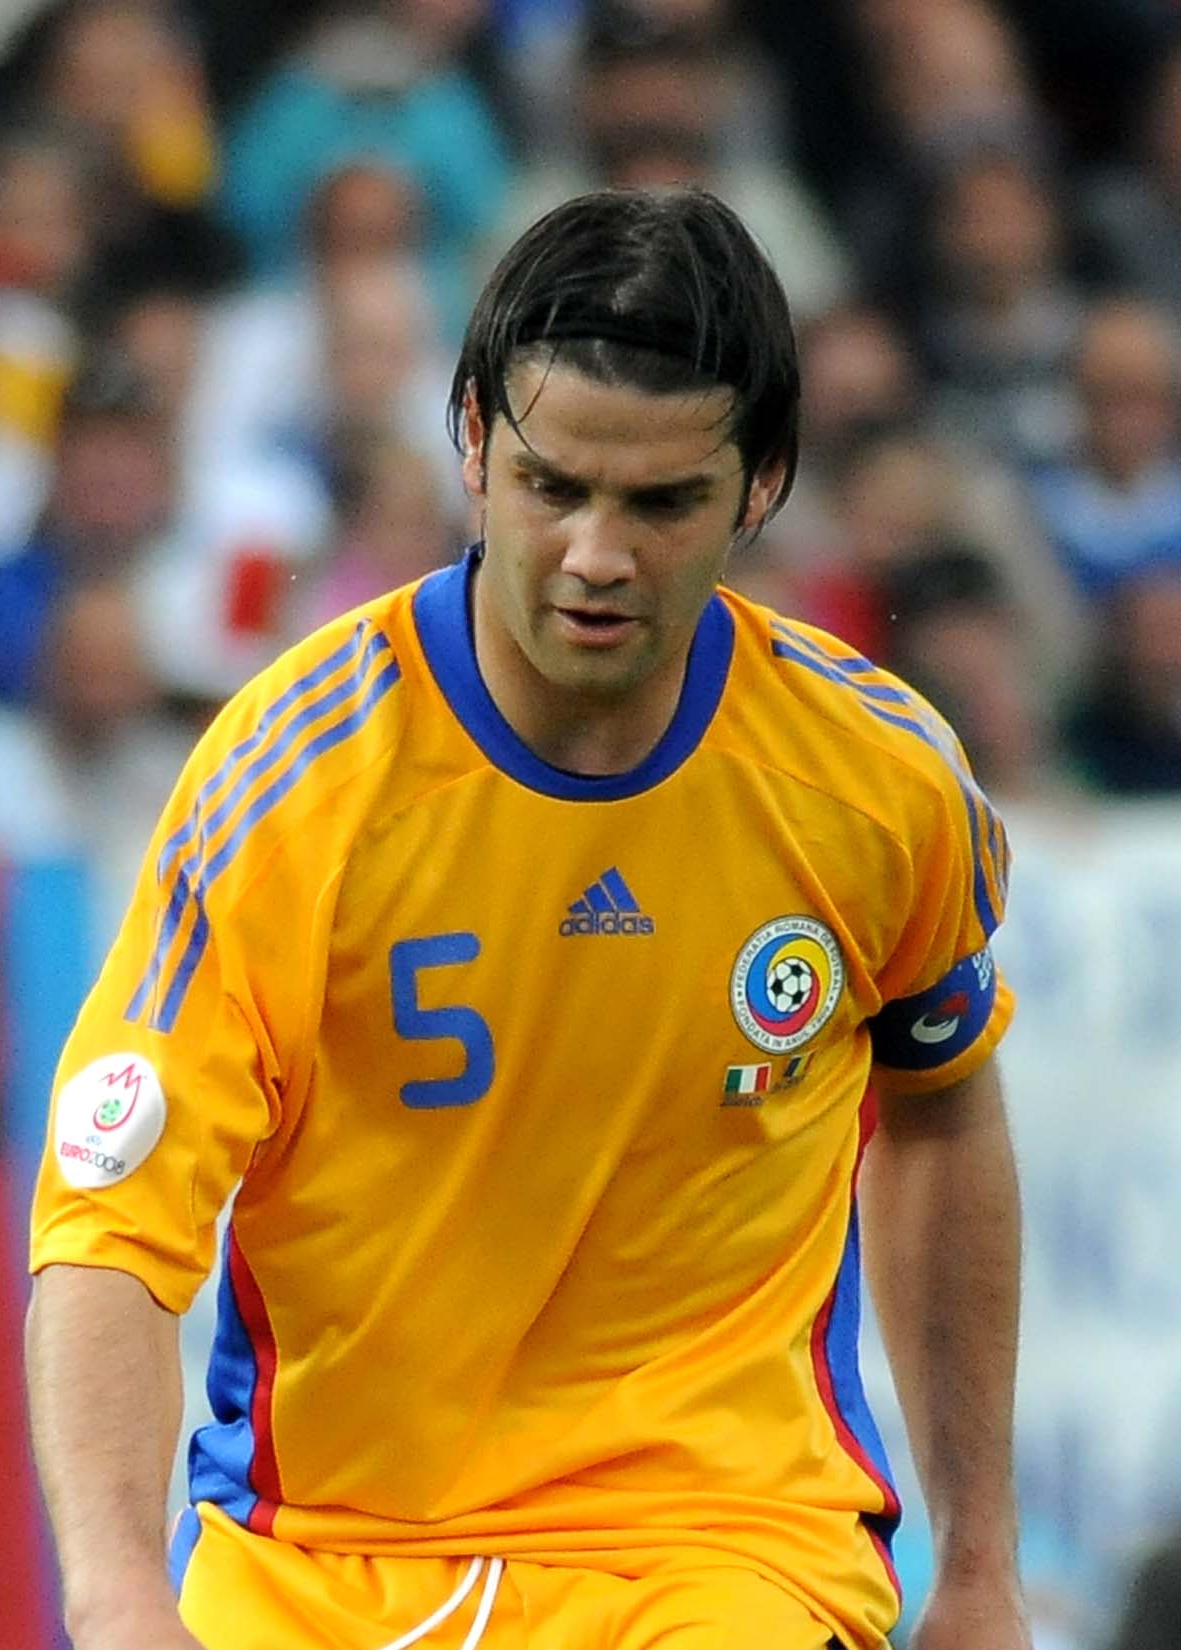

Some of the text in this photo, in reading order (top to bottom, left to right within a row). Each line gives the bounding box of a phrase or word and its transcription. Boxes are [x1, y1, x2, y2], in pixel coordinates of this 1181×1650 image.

[559, 911, 654, 936] adidas
[389, 931, 496, 1110] 5
[736, 1000, 770, 1044] FONDATA
